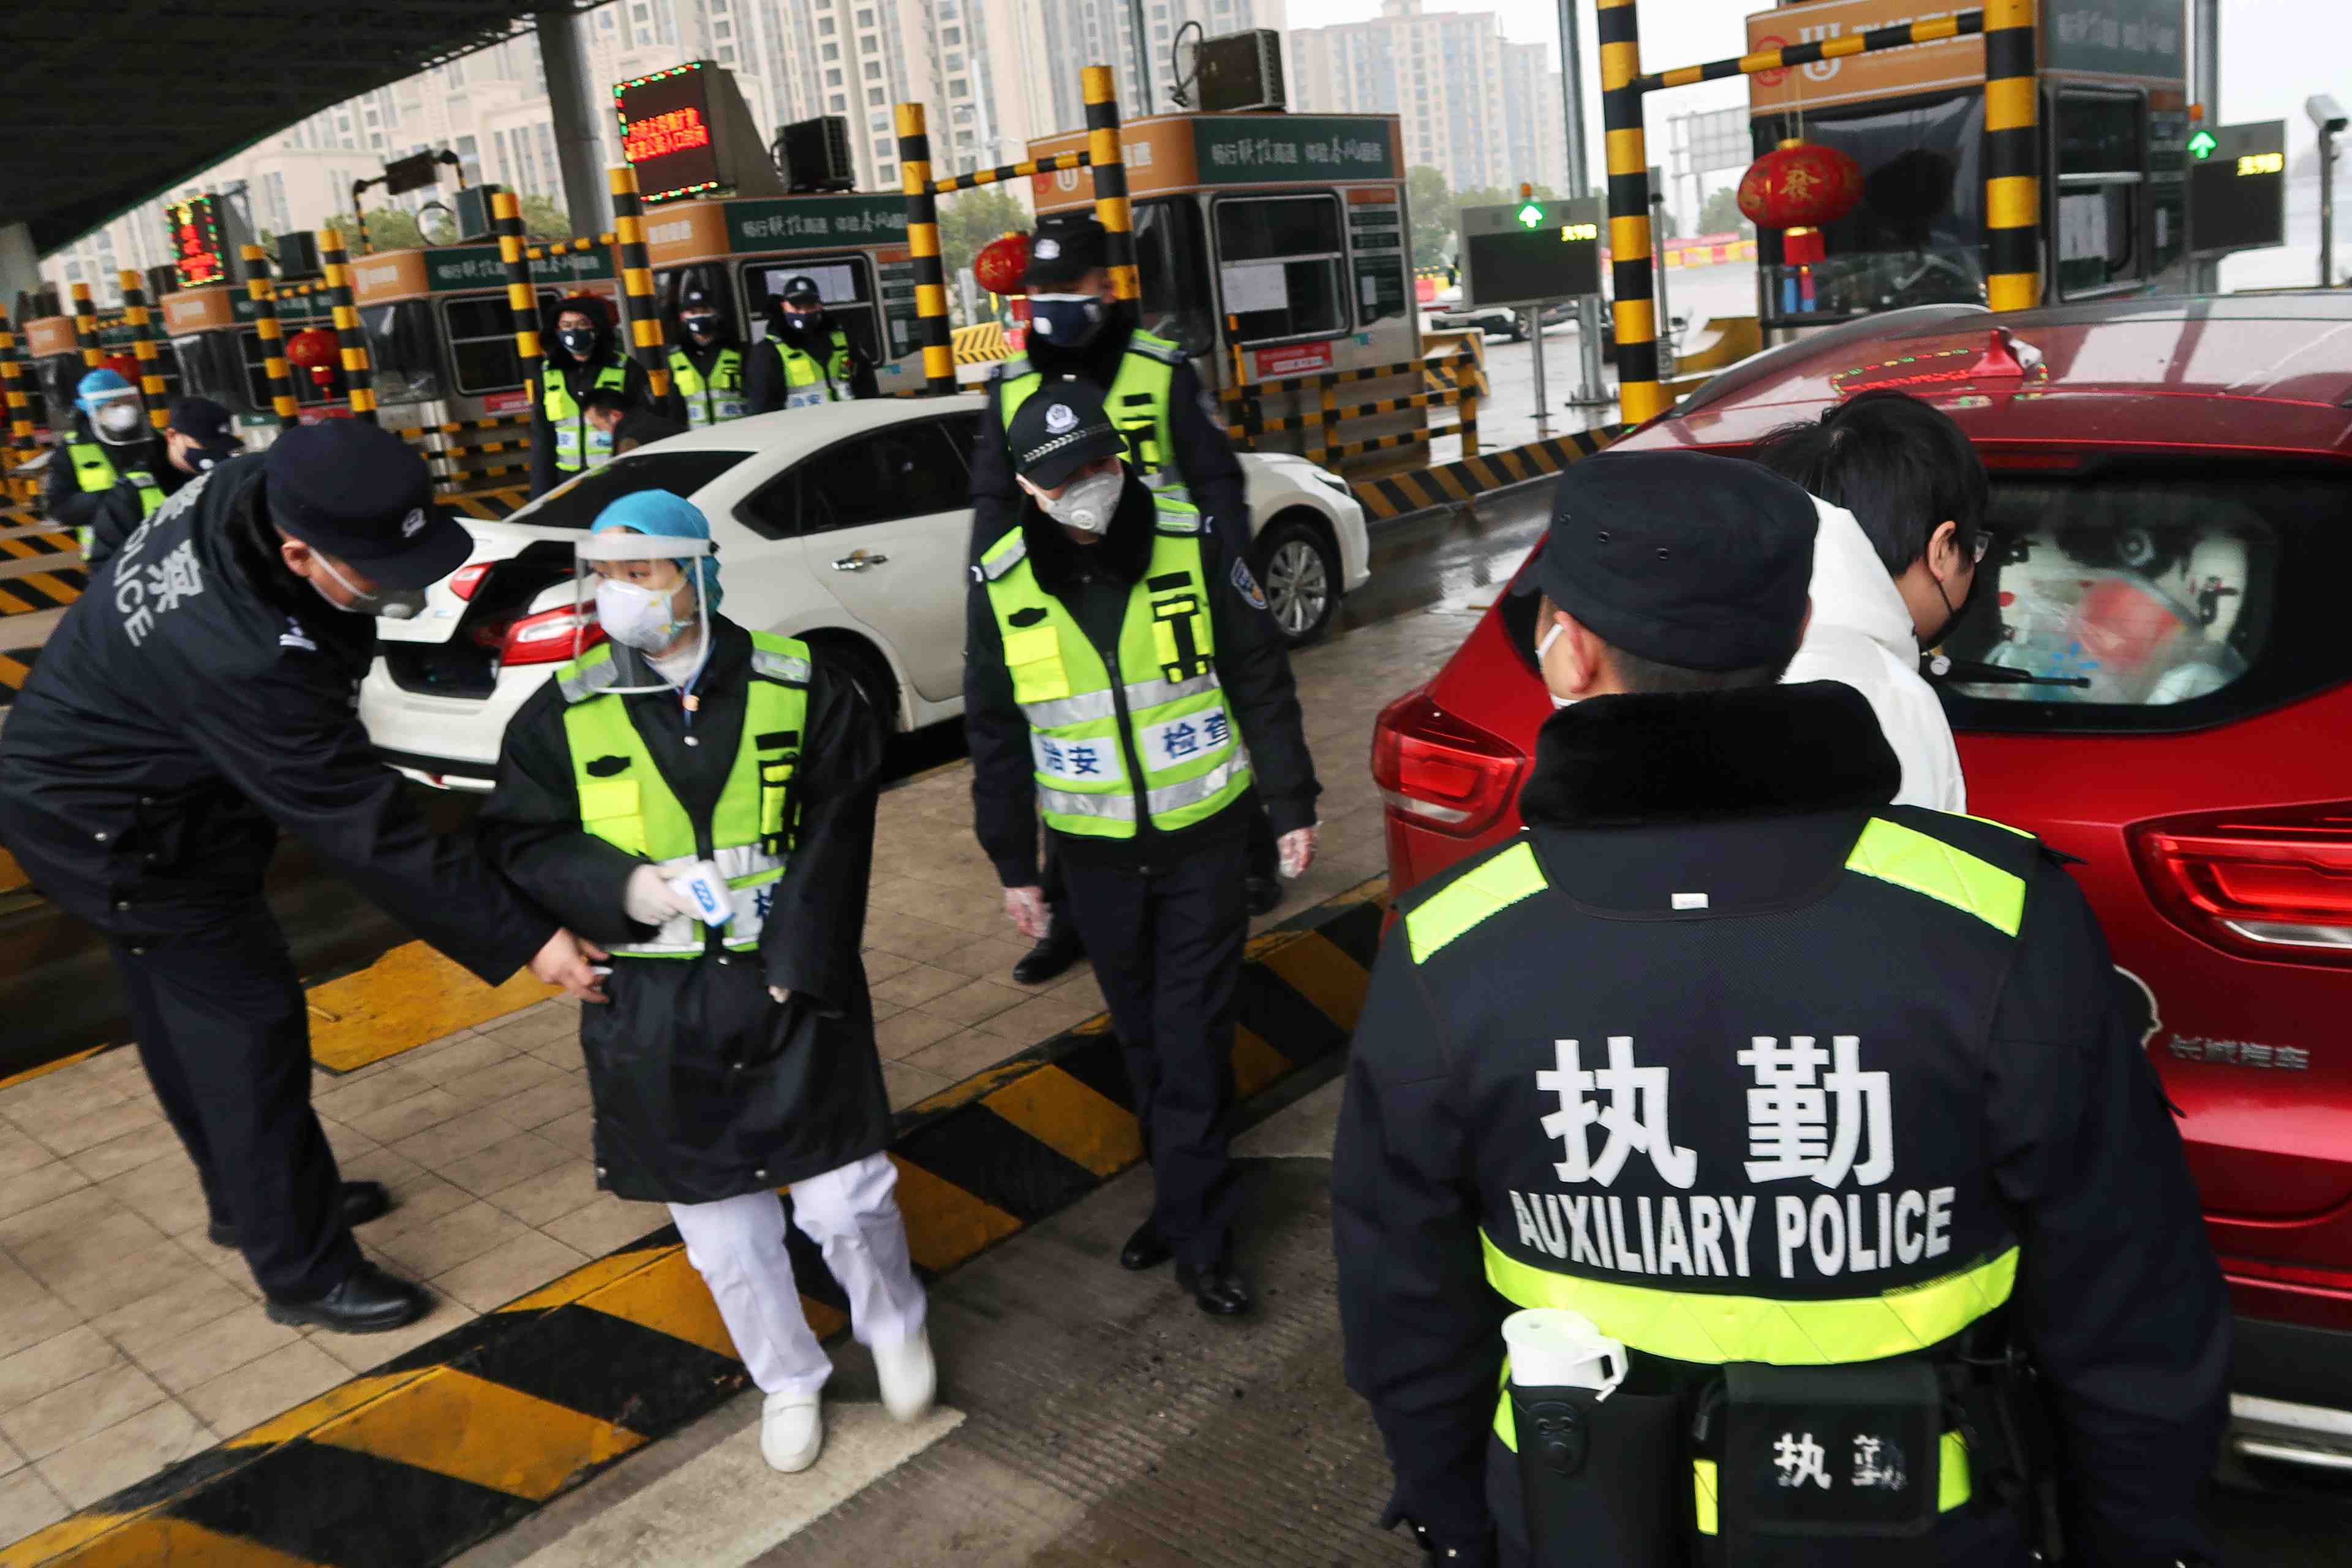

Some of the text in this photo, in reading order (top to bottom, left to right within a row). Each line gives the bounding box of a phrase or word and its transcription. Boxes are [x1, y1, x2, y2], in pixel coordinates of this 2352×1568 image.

[113, 516, 154, 647] OLICE
[1163, 712, 1230, 760] 检查
[1536, 1036, 1894, 1189] 执勤
[1509, 1186, 1956, 1278] AUXILIARY POLICE
